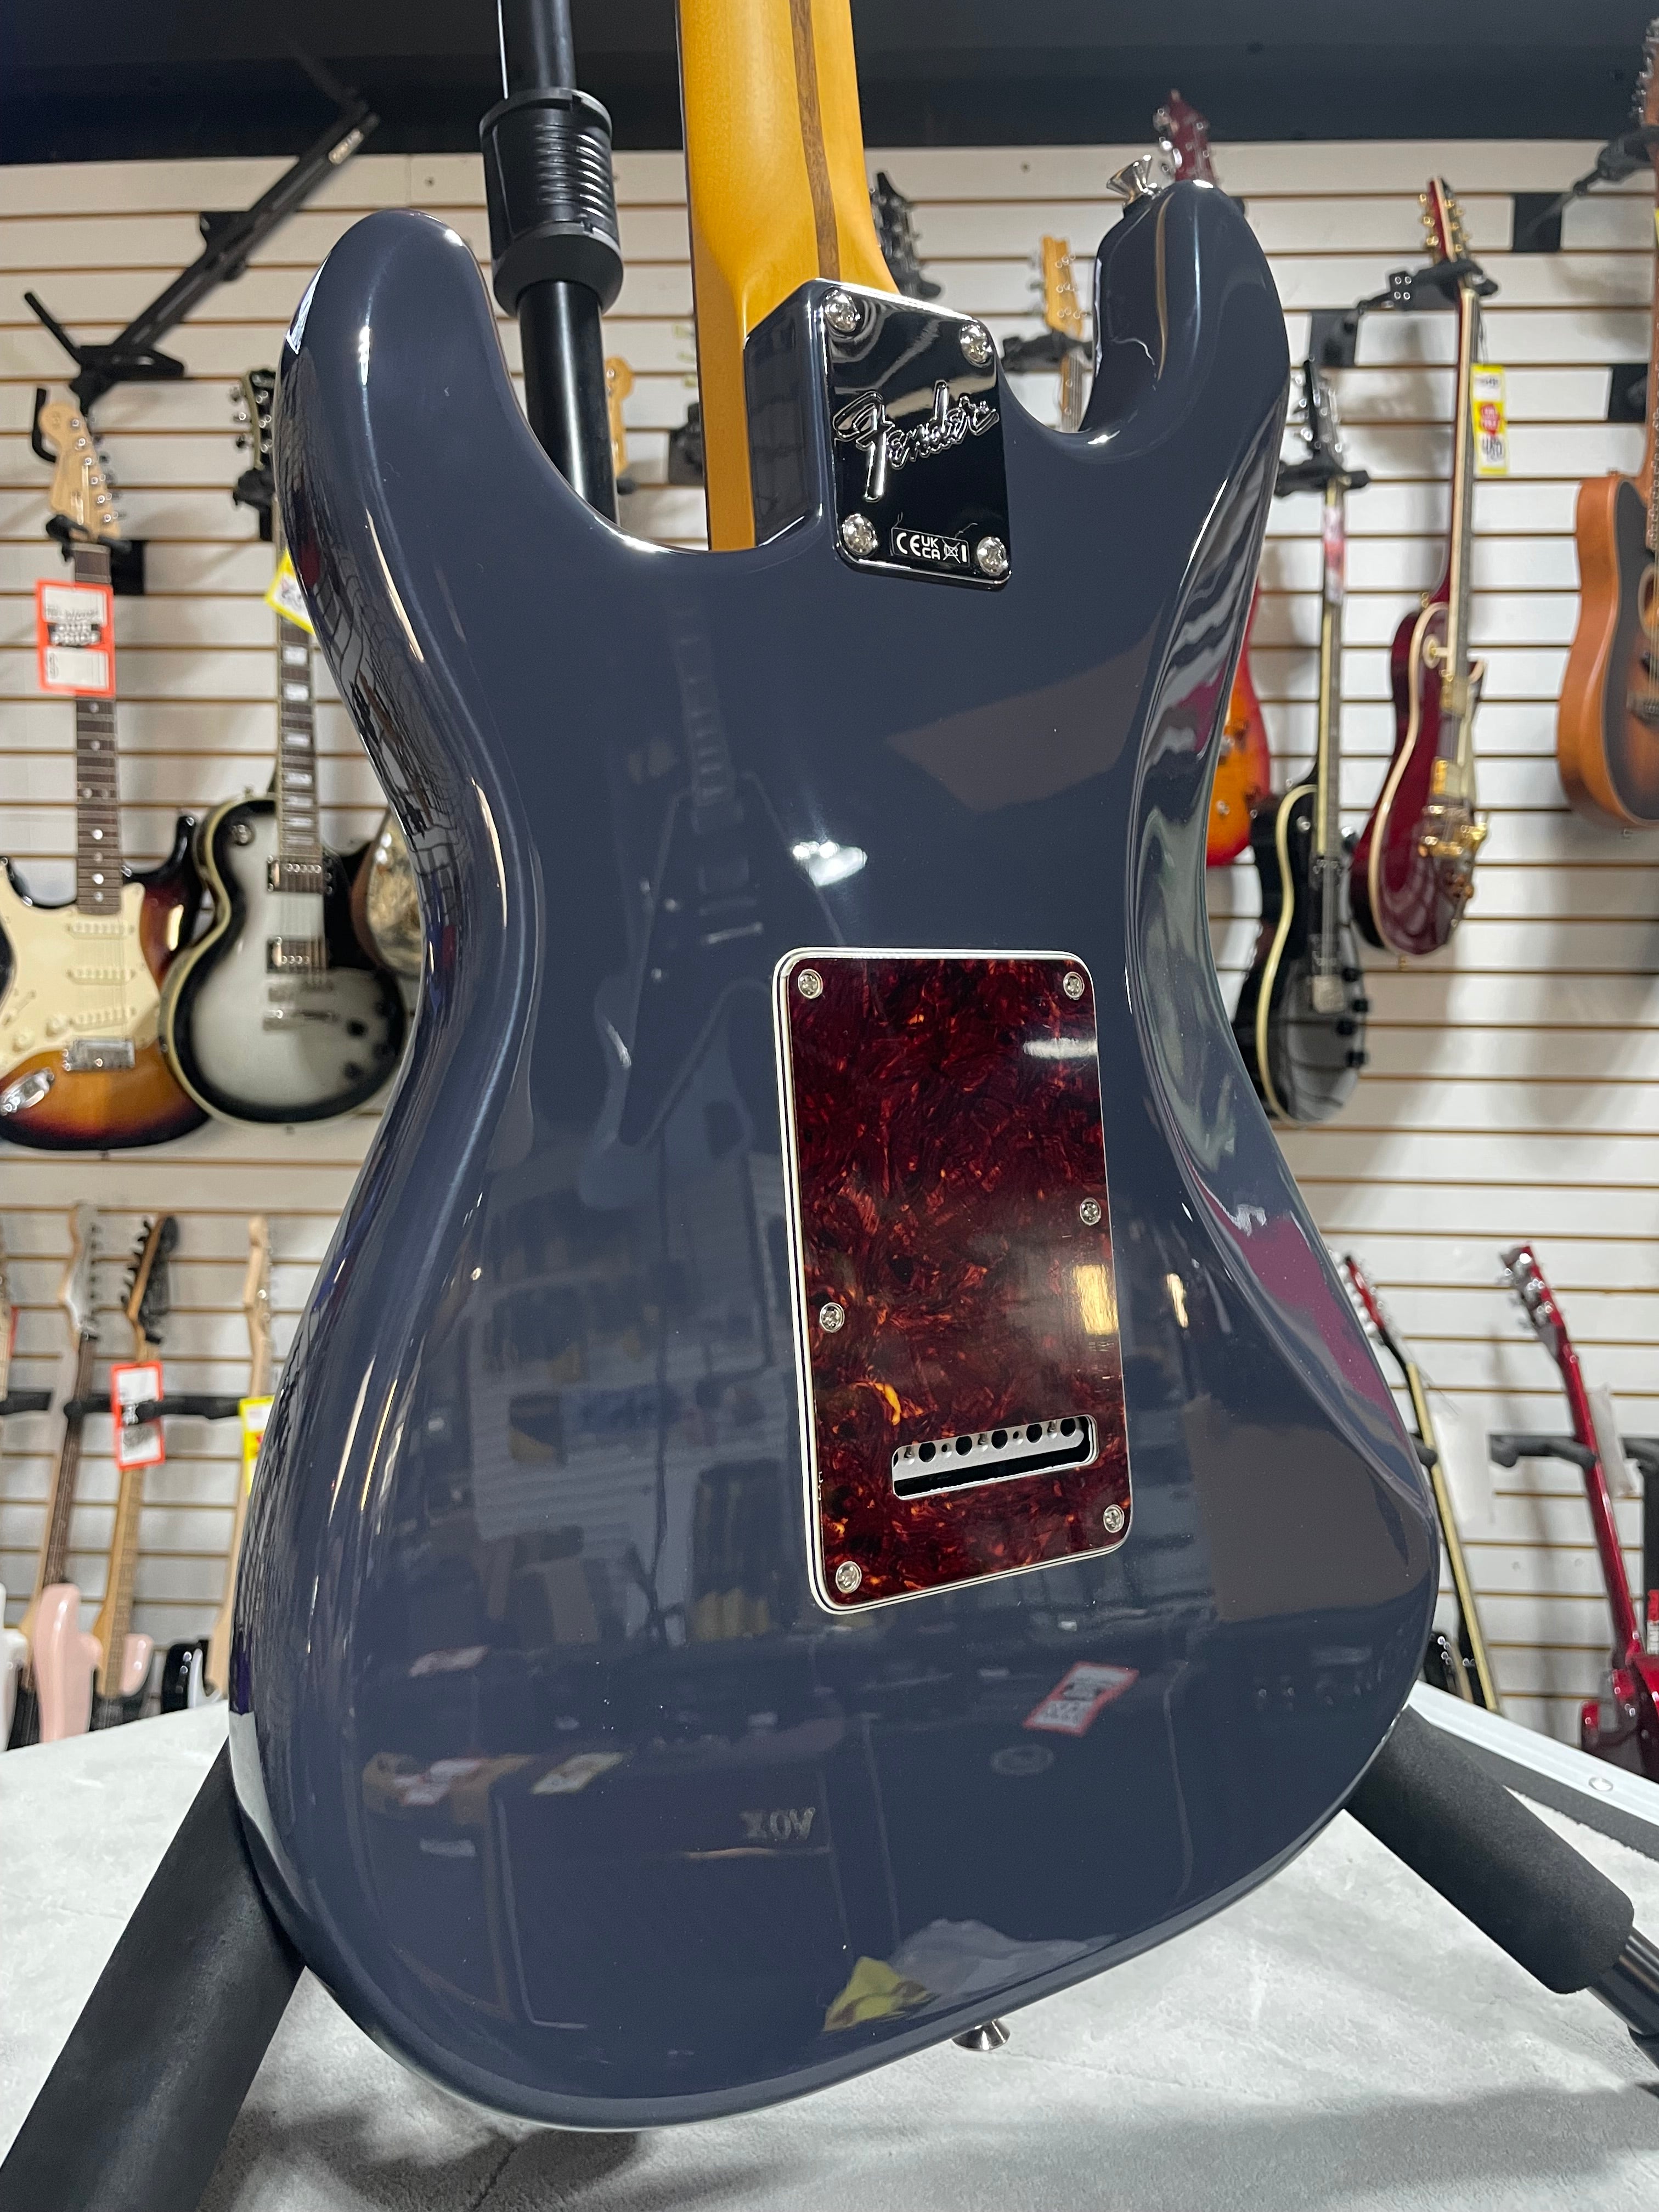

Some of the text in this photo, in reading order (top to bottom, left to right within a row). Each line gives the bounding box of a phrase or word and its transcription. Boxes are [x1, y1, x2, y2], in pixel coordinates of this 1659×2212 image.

[832, 380, 999, 503] Fender
[921, 535, 939, 549] UK
[922, 546, 941, 560] CA
